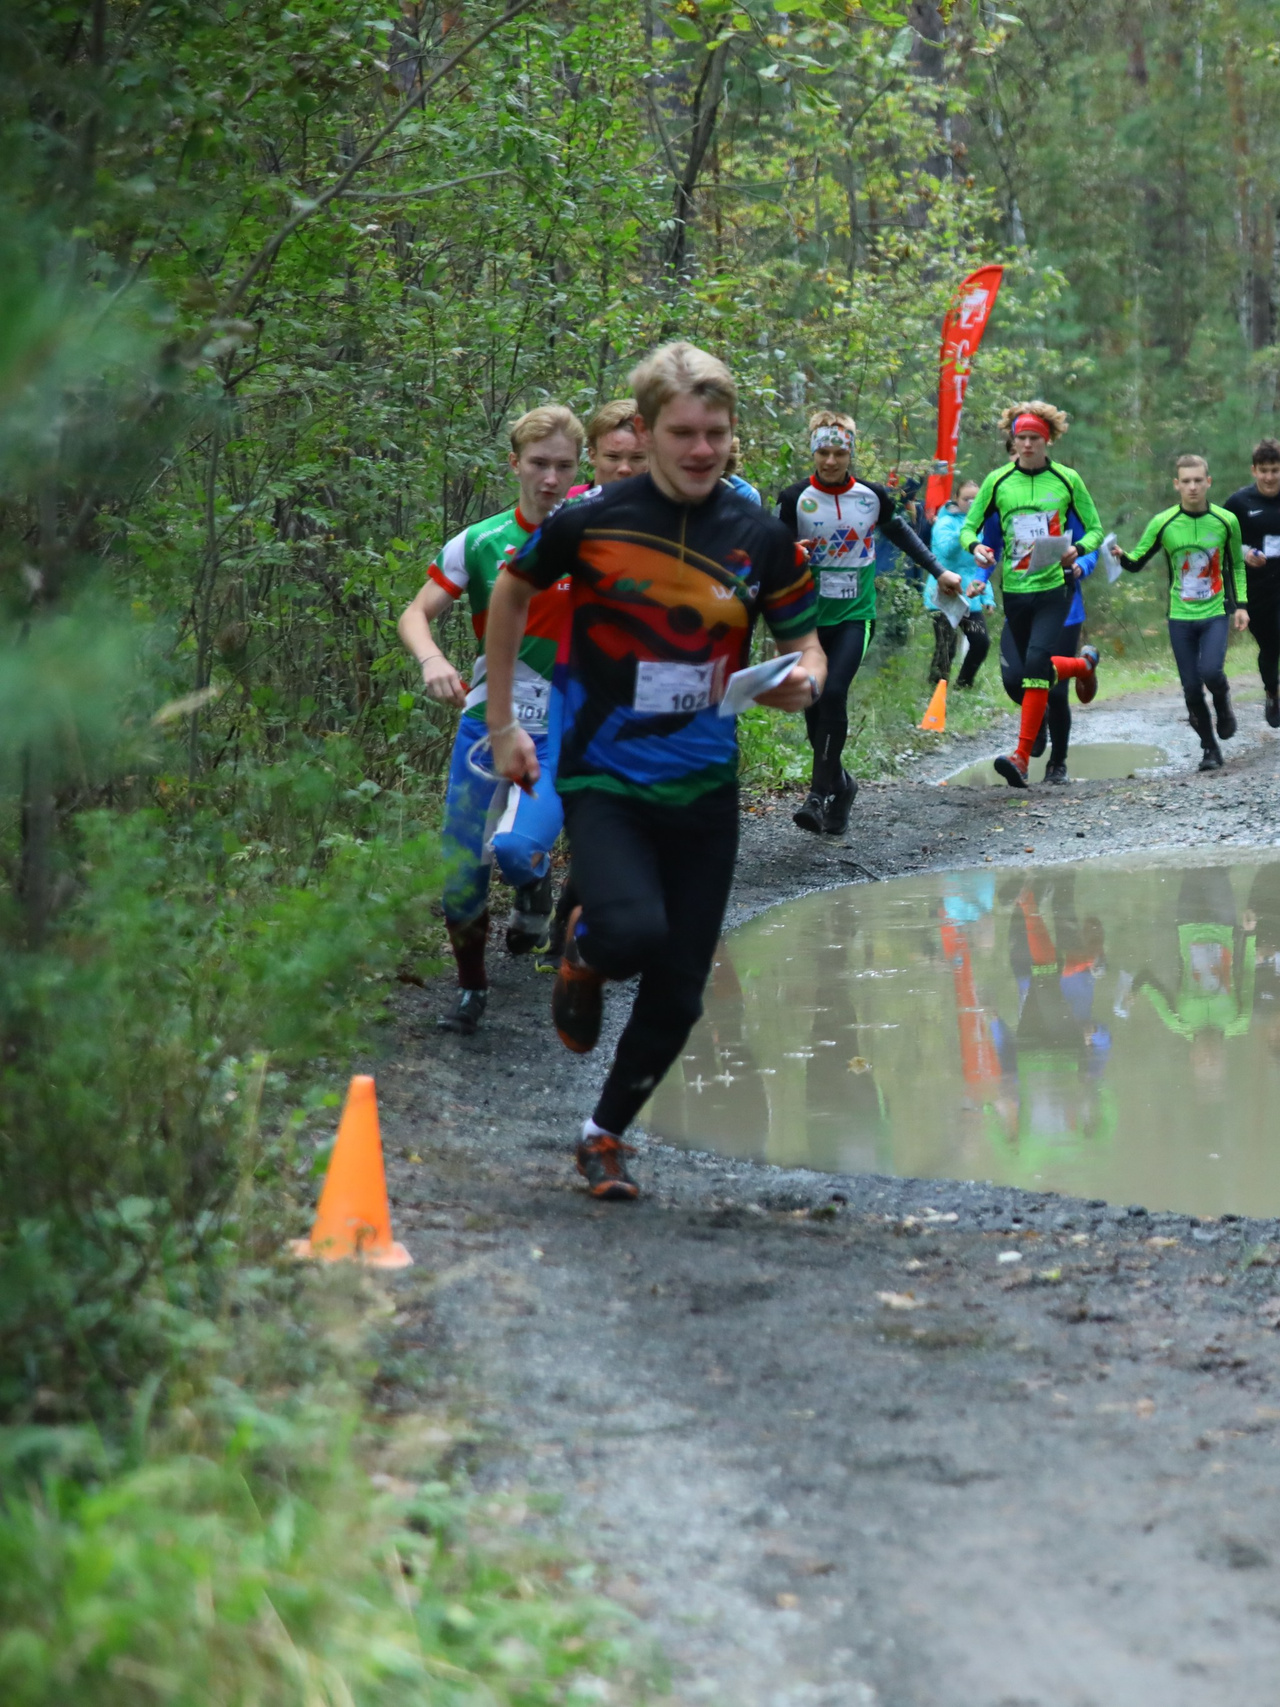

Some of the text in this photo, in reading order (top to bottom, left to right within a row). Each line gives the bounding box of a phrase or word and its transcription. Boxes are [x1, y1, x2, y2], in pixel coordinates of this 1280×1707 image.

[1030, 528, 1045, 537] 116
[840, 588, 856, 598] 111
[672, 692, 707, 711] 102
[518, 704, 542, 719] 101
